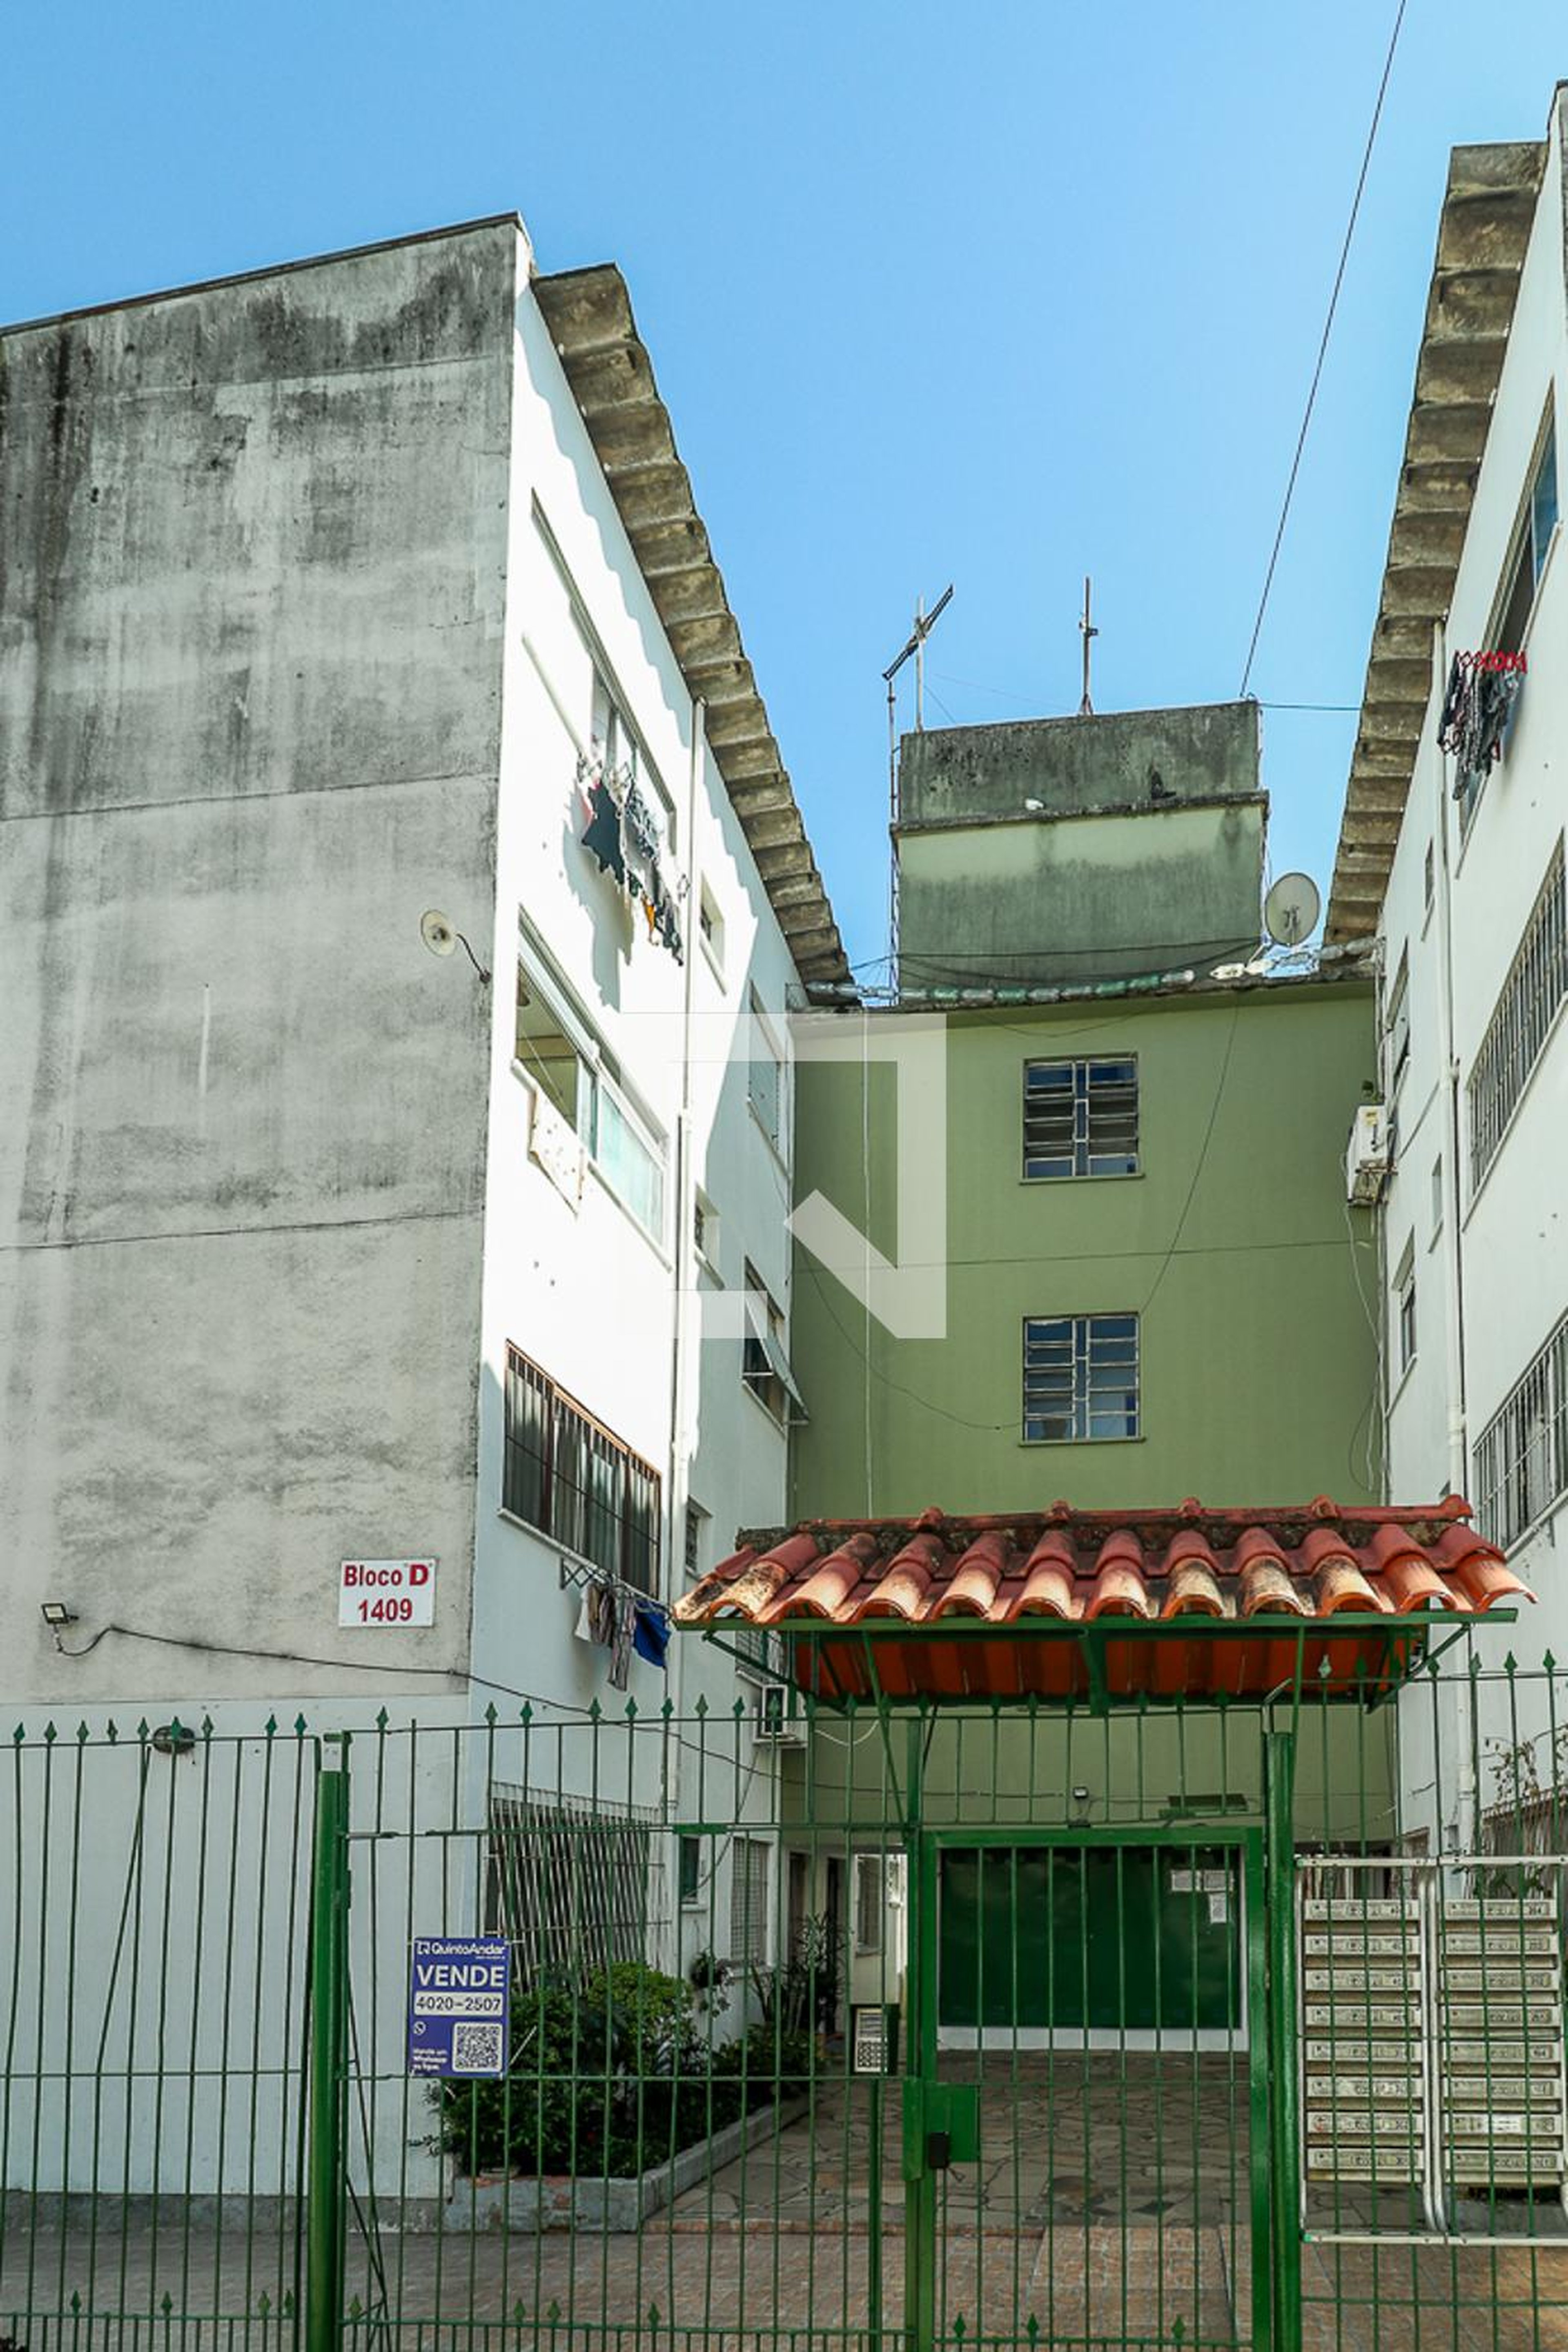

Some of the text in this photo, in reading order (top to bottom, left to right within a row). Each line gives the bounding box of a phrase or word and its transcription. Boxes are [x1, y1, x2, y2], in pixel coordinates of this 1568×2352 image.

[344, 1564, 429, 1586] Bloco D
[358, 1598, 412, 1622] 1409
[431, 1942, 505, 1955] QuintoAndar
[416, 1964, 505, 1987] VENDE
[416, 1996, 501, 2011] 4020-2507
